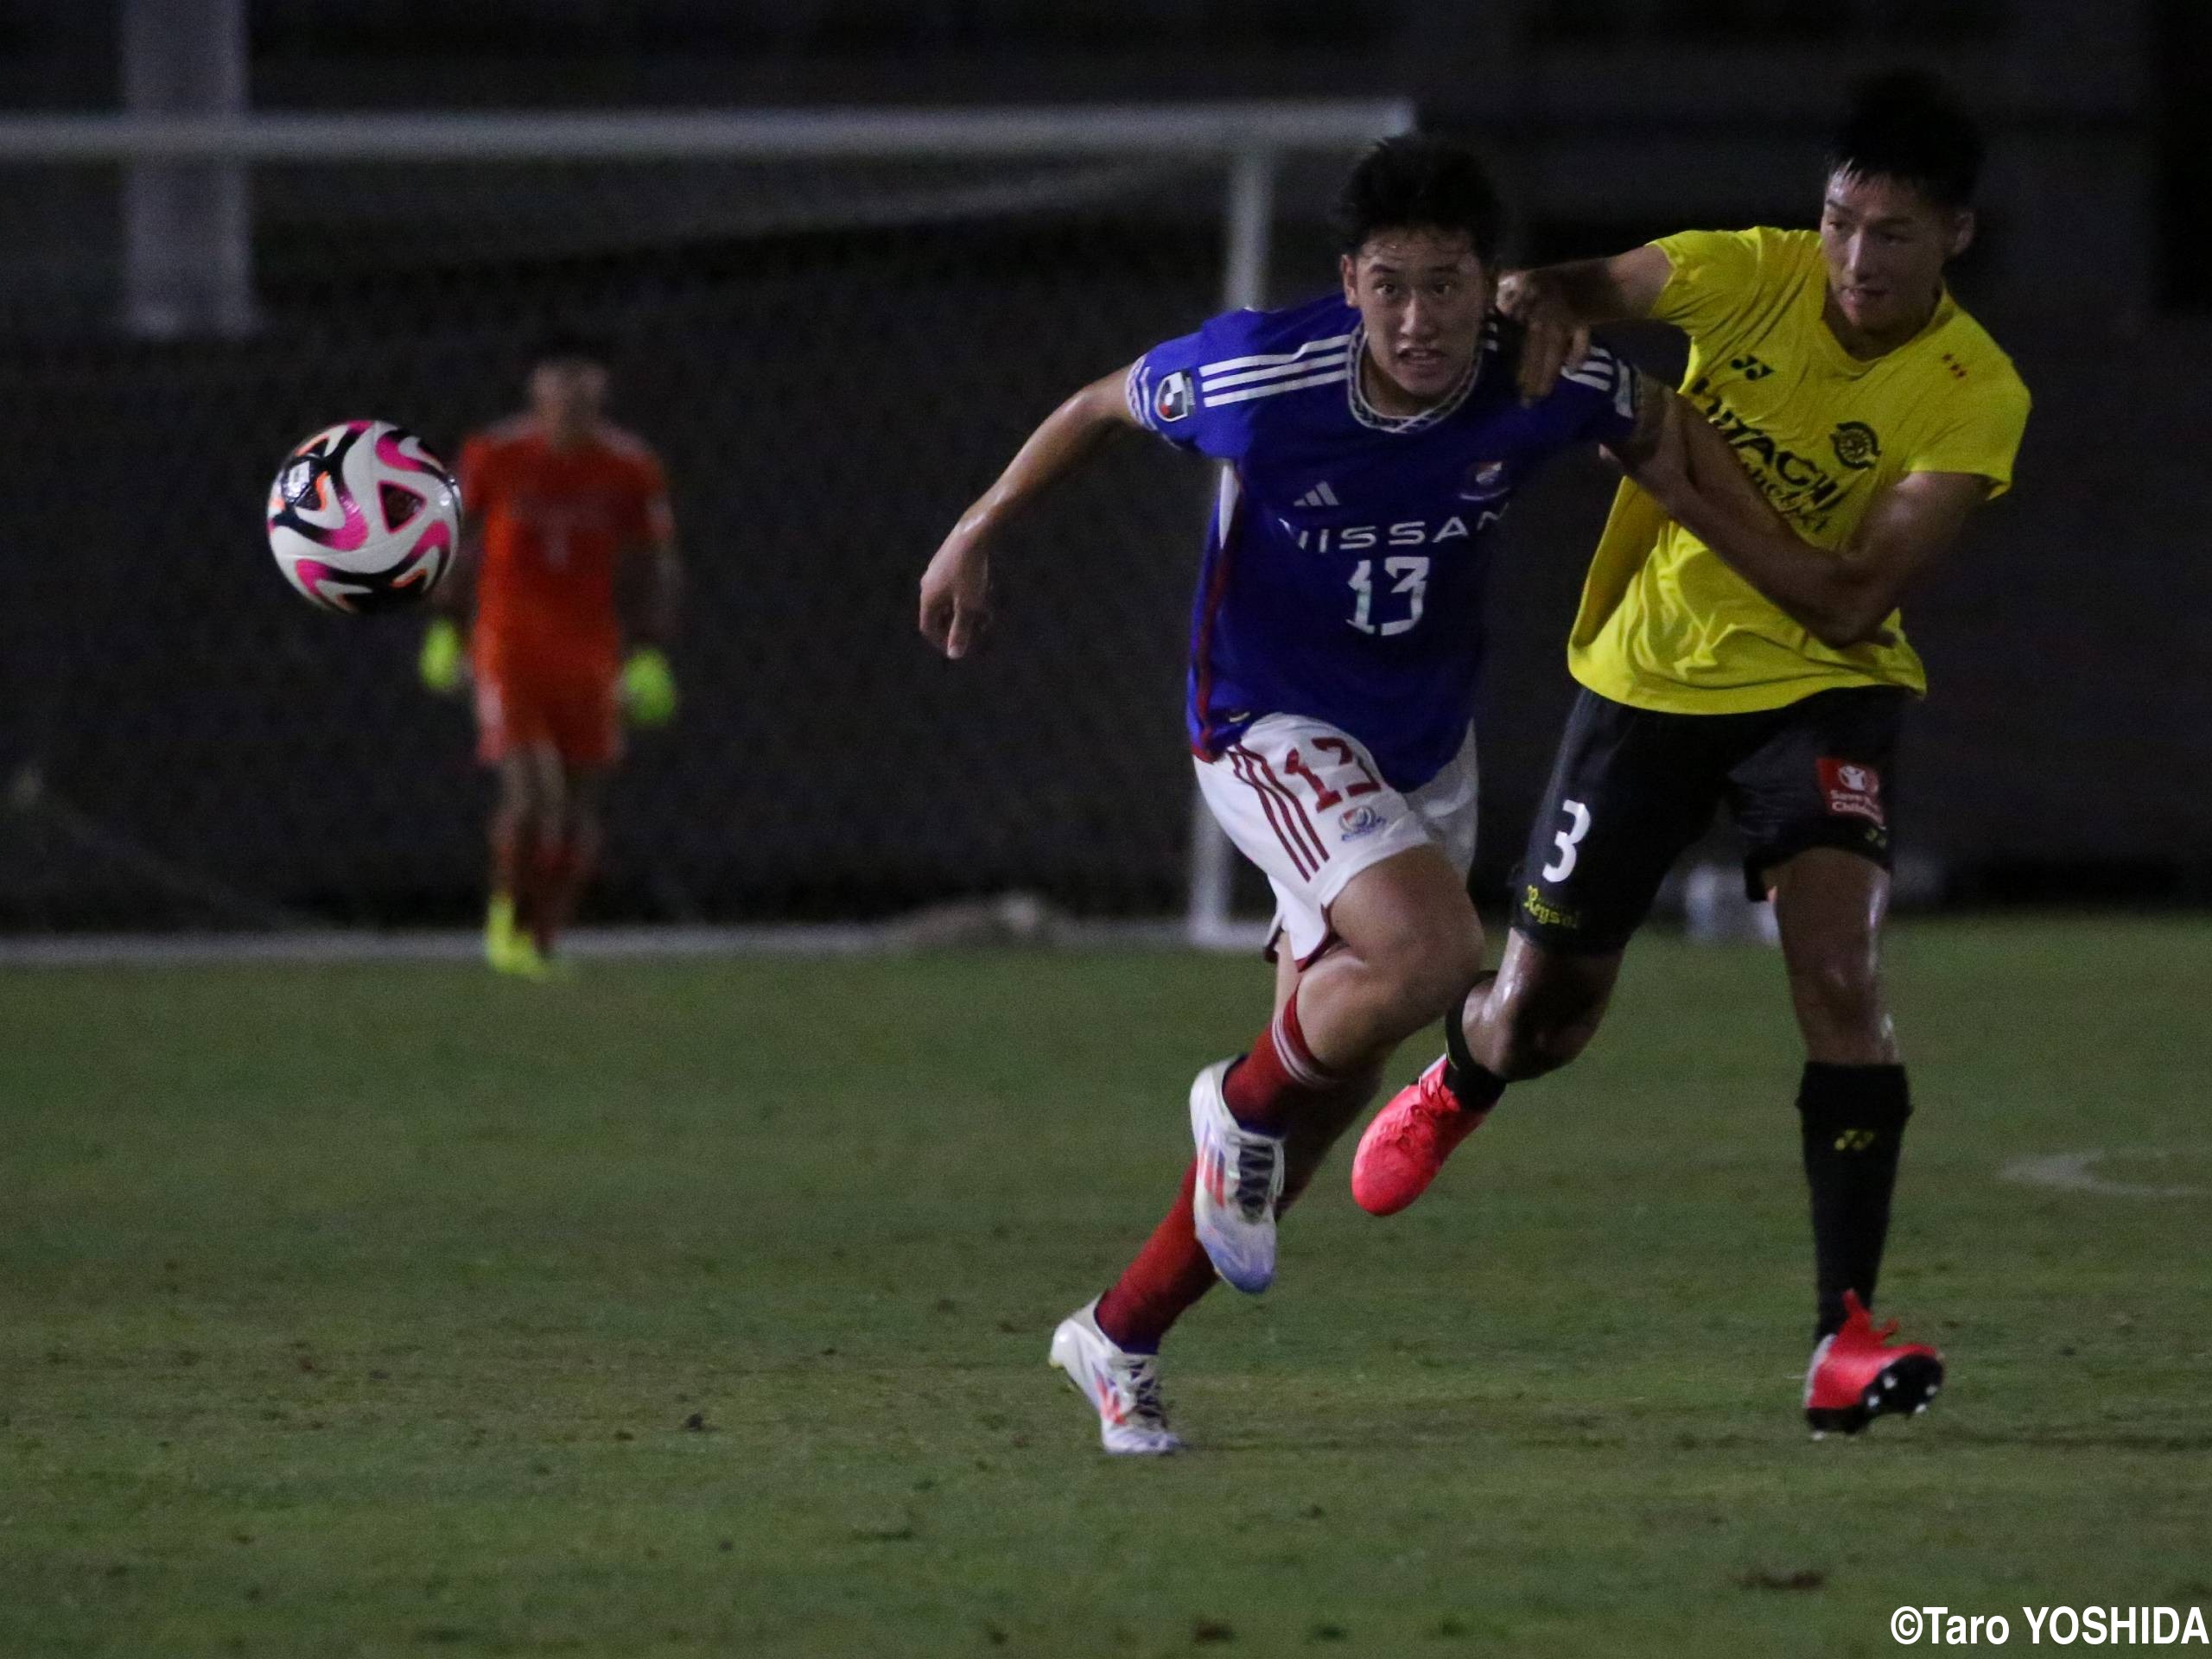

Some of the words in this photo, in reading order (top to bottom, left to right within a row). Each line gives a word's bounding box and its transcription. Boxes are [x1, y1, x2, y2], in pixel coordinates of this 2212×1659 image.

[1344, 556, 1431, 637] 13
[1284, 736, 1382, 813] 13
[1541, 799, 1592, 883] 3
